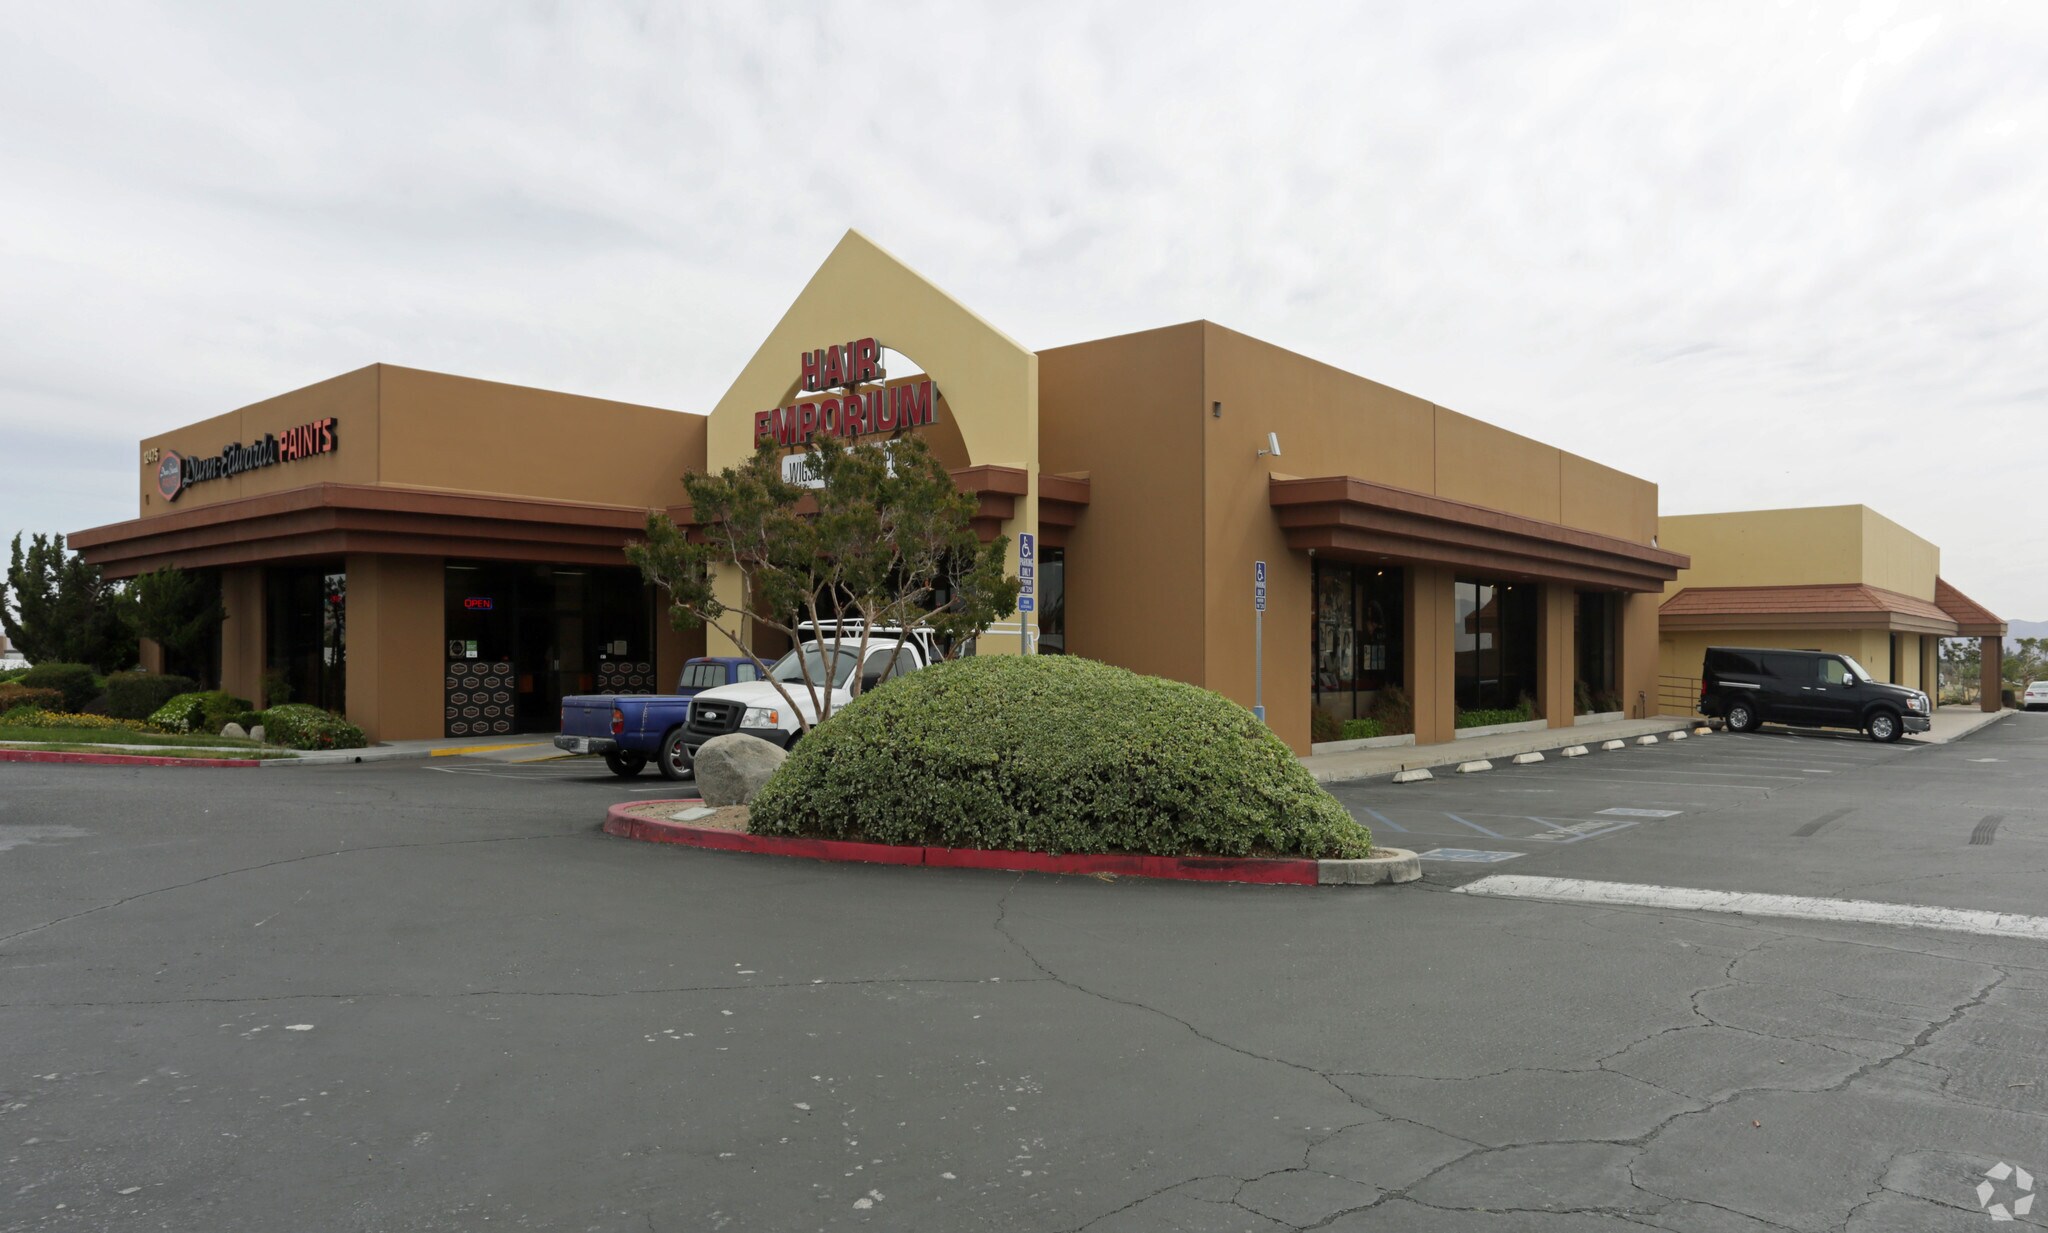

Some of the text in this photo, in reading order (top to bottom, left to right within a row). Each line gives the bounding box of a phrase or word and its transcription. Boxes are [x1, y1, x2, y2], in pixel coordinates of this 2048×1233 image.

[801, 337, 880, 391] HAIR
[754, 380, 936, 449] EMPORIUM
[182, 433, 276, 488] Dunn-Edwards
[279, 417, 337, 462] PAINTS
[464, 599, 491, 608] OPEN
